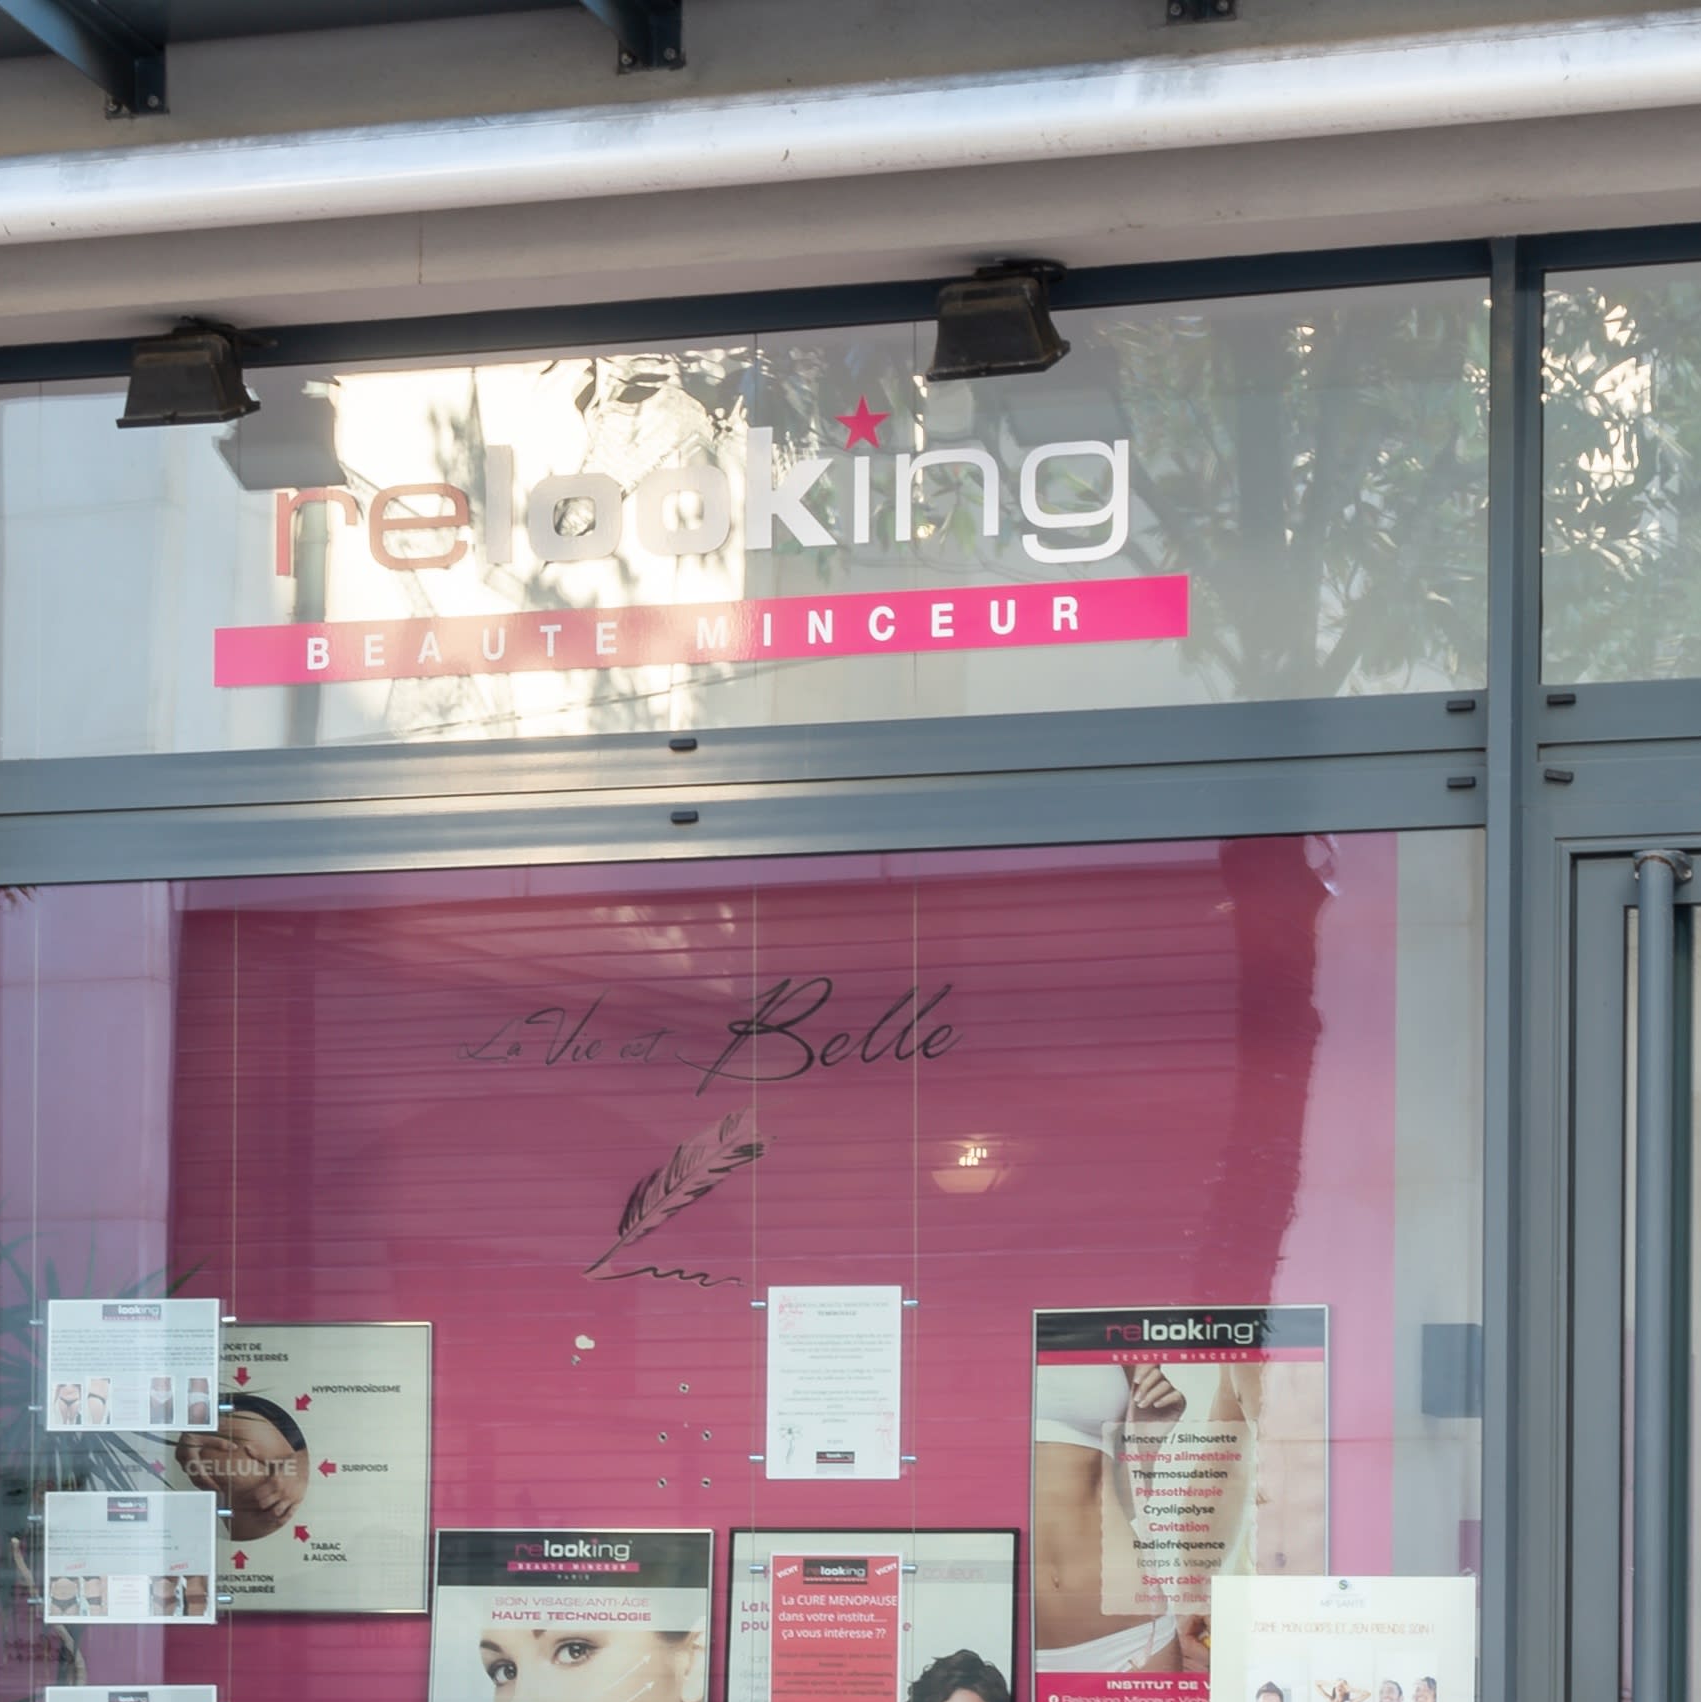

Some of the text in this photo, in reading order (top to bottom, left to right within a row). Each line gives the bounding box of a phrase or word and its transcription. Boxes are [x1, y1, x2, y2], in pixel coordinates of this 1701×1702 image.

[274, 396, 1130, 577] relooking
[306, 595, 1081, 671] BEAUTE MINCEUR
[675, 977, 963, 1097] Belle
[1106, 1315, 1254, 1344] relooking
[249, 1343, 262, 1351] DE
[1180, 1352, 1248, 1360] MINCEUR
[1122, 1434, 1168, 1444] Minceur
[1177, 1433, 1237, 1444] Silhouette
[1118, 1451, 1242, 1463] Coaching alimentaire
[185, 1458, 299, 1477] CELLULITE
[341, 1463, 389, 1473] SURPOIDS
[1132, 1469, 1228, 1479] Thermosudation
[1135, 1486, 1224, 1499] Pressothérapie
[1143, 1504, 1215, 1516] Cryolipolyse
[1149, 1522, 1210, 1532] Cavitation
[310, 1542, 341, 1550] TABAC
[515, 1539, 630, 1562] relooking
[1133, 1540, 1226, 1551] Radiofréquence
[312, 1554, 348, 1562] ALCOOL
[1184, 1557, 1222, 1569] visage)
[572, 1563, 627, 1571] MINCEUR
[1142, 1575, 1174, 1587] Sport
[797, 1595, 826, 1606] CURE
[829, 1595, 898, 1607] MENOPAUSE
[491, 1611, 652, 1622] HAUTE TECHNOLOGIE
[778, 1611, 835, 1623] dans votre
[781, 1629, 795, 1640] ça
[796, 1630, 822, 1638] vous
[824, 1627, 874, 1639] intéresse
[1106, 1680, 1174, 1690] INSTITUT
[1178, 1681, 1199, 1690] DE
